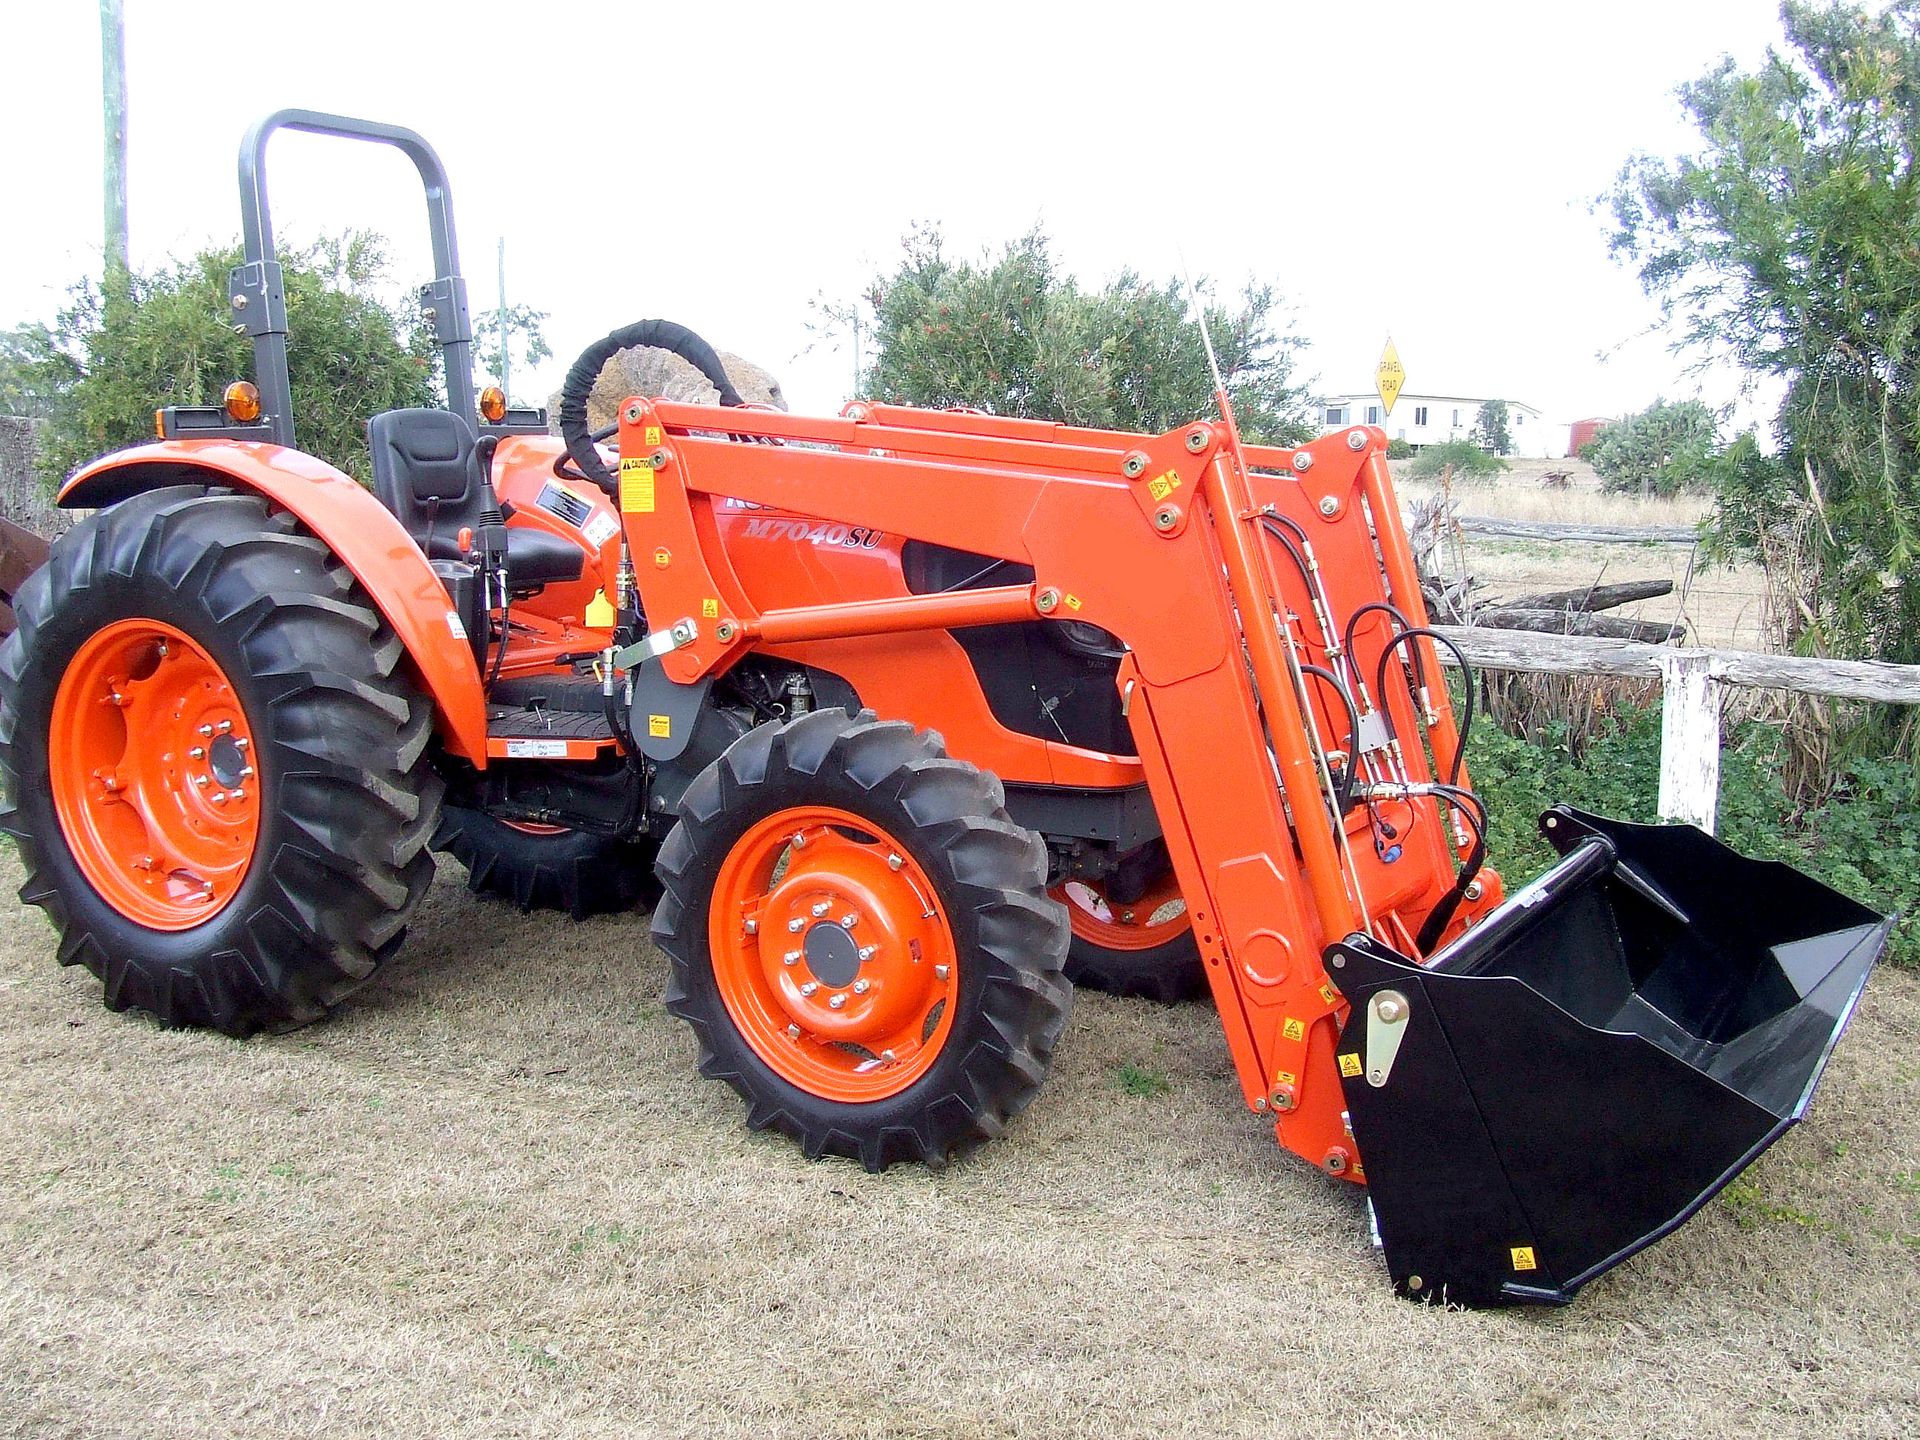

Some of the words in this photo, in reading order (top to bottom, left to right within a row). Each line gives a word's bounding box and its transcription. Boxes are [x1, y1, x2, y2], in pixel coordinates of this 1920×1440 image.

[1380, 361, 1401, 372] GRAVEL
[1382, 379, 1397, 391] ROAD
[631, 459, 651, 468] CAUTIO
[742, 518, 884, 549] M7040SU
